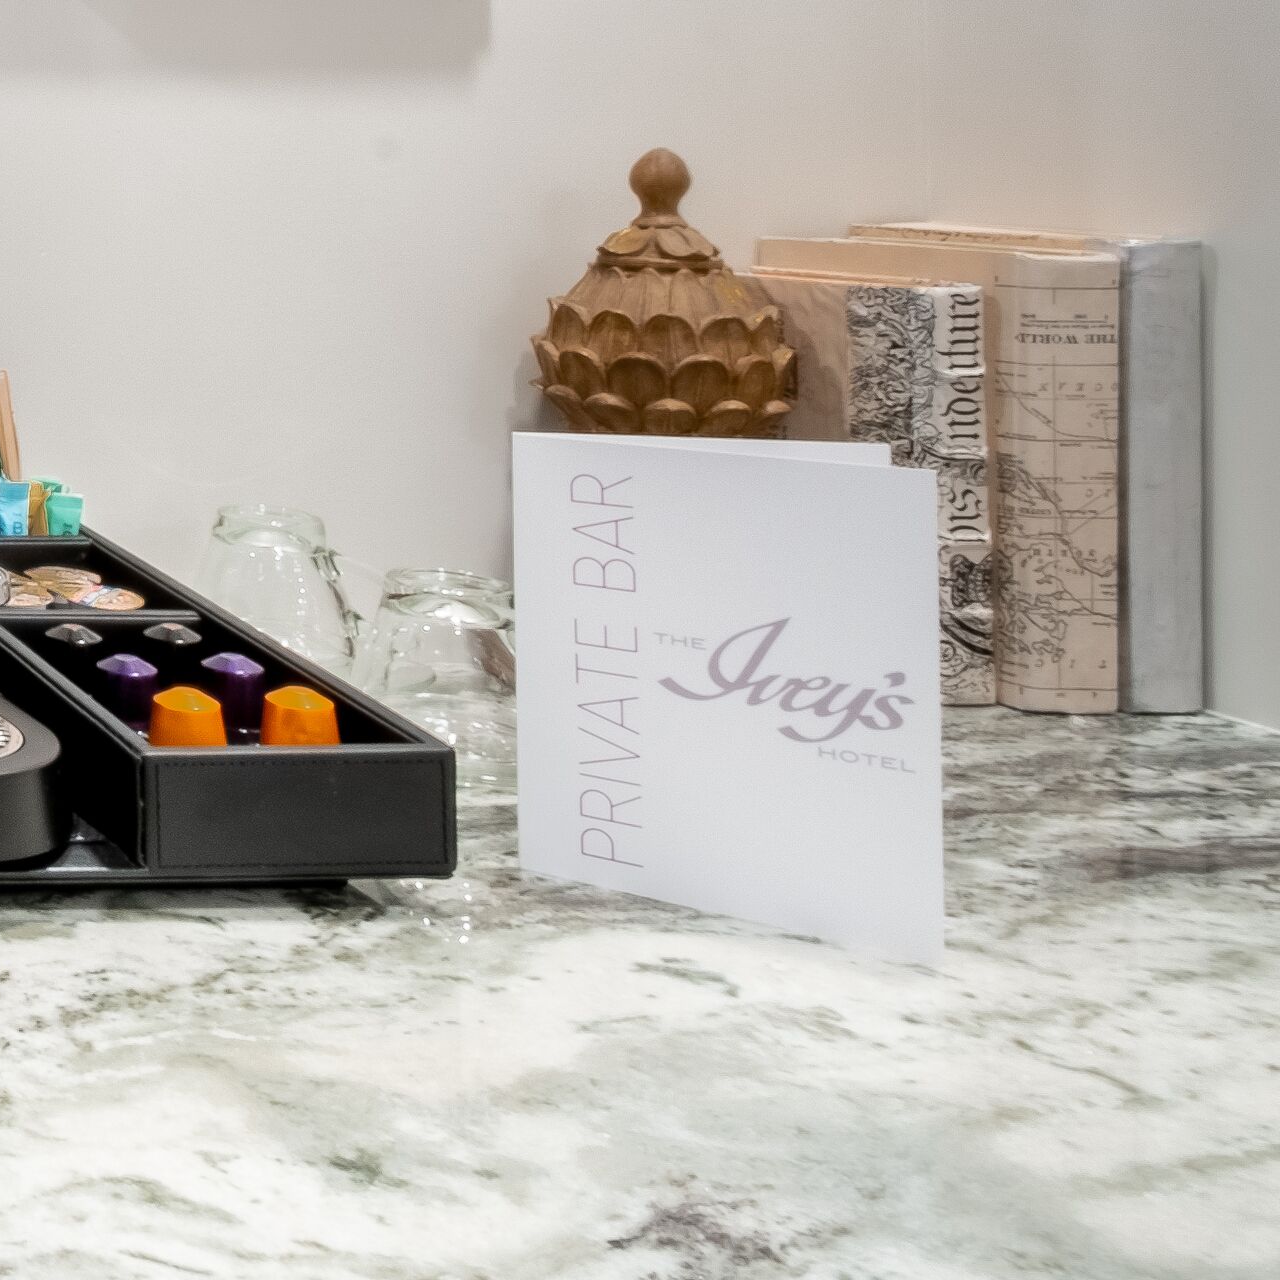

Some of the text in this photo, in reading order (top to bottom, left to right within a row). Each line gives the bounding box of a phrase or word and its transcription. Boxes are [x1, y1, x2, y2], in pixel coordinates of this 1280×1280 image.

[1014, 332, 1078, 345] WORLD
[568, 472, 644, 870] PRIVATE BAR
[652, 616, 916, 743] THE Ivey's
[817, 745, 918, 775] HOTEL
